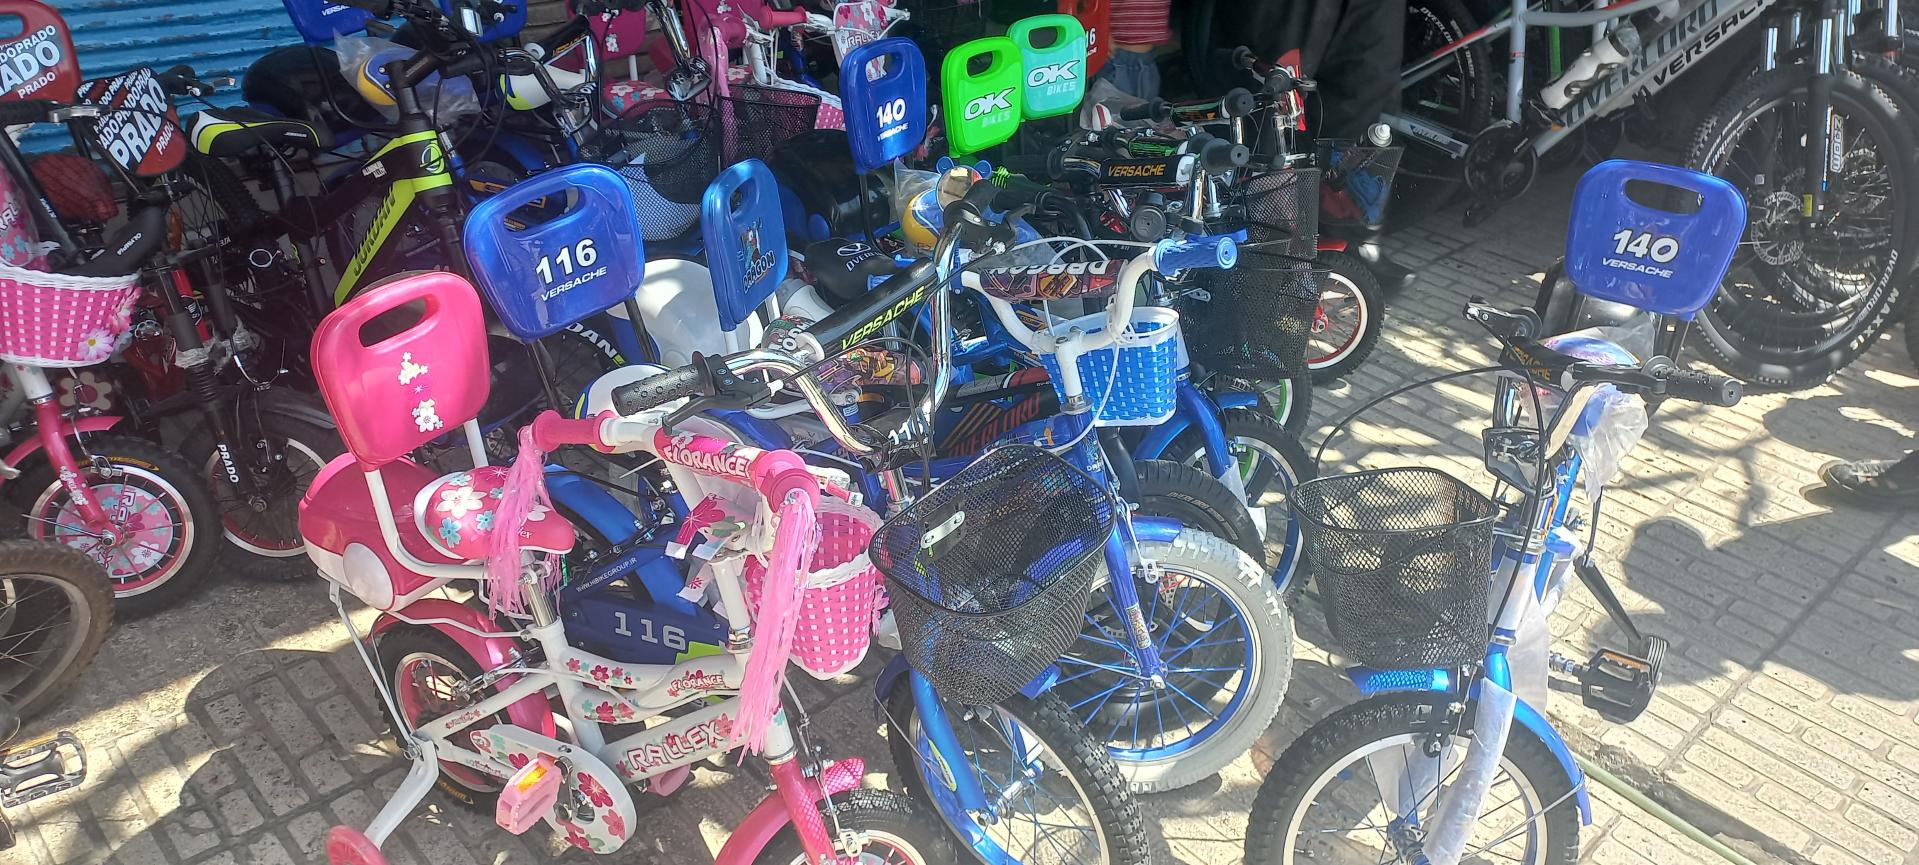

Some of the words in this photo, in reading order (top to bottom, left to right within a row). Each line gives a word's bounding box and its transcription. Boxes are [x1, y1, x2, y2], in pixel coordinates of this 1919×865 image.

[0, 41, 60, 97] ADO
[17, 72, 55, 99] PRADO
[1027, 60, 1080, 87] OK
[964, 87, 1016, 120] OK
[1047, 82, 1076, 95] BIKES
[109, 77, 168, 170] PRADO
[876, 98, 906, 129] 140
[1107, 163, 1167, 178] VERSACHE
[116, 232, 142, 256] OLYMPIA
[535, 238, 598, 286] 116
[1613, 228, 1679, 264] 140
[541, 265, 608, 302] VERSACHE
[743, 251, 776, 295] DRAGON
[1602, 256, 1674, 279] VERSACHE
[1863, 248, 1899, 312] OVERLORD
[841, 285, 925, 350] VERSACHE
[1849, 287, 1900, 351] MAXXIS
[217, 443, 241, 484] PRADO
[663, 444, 749, 478] FLORANCE
[614, 611, 687, 651] 116
[671, 673, 725, 692] FLORANCE
[626, 719, 725, 770] RALLEX
